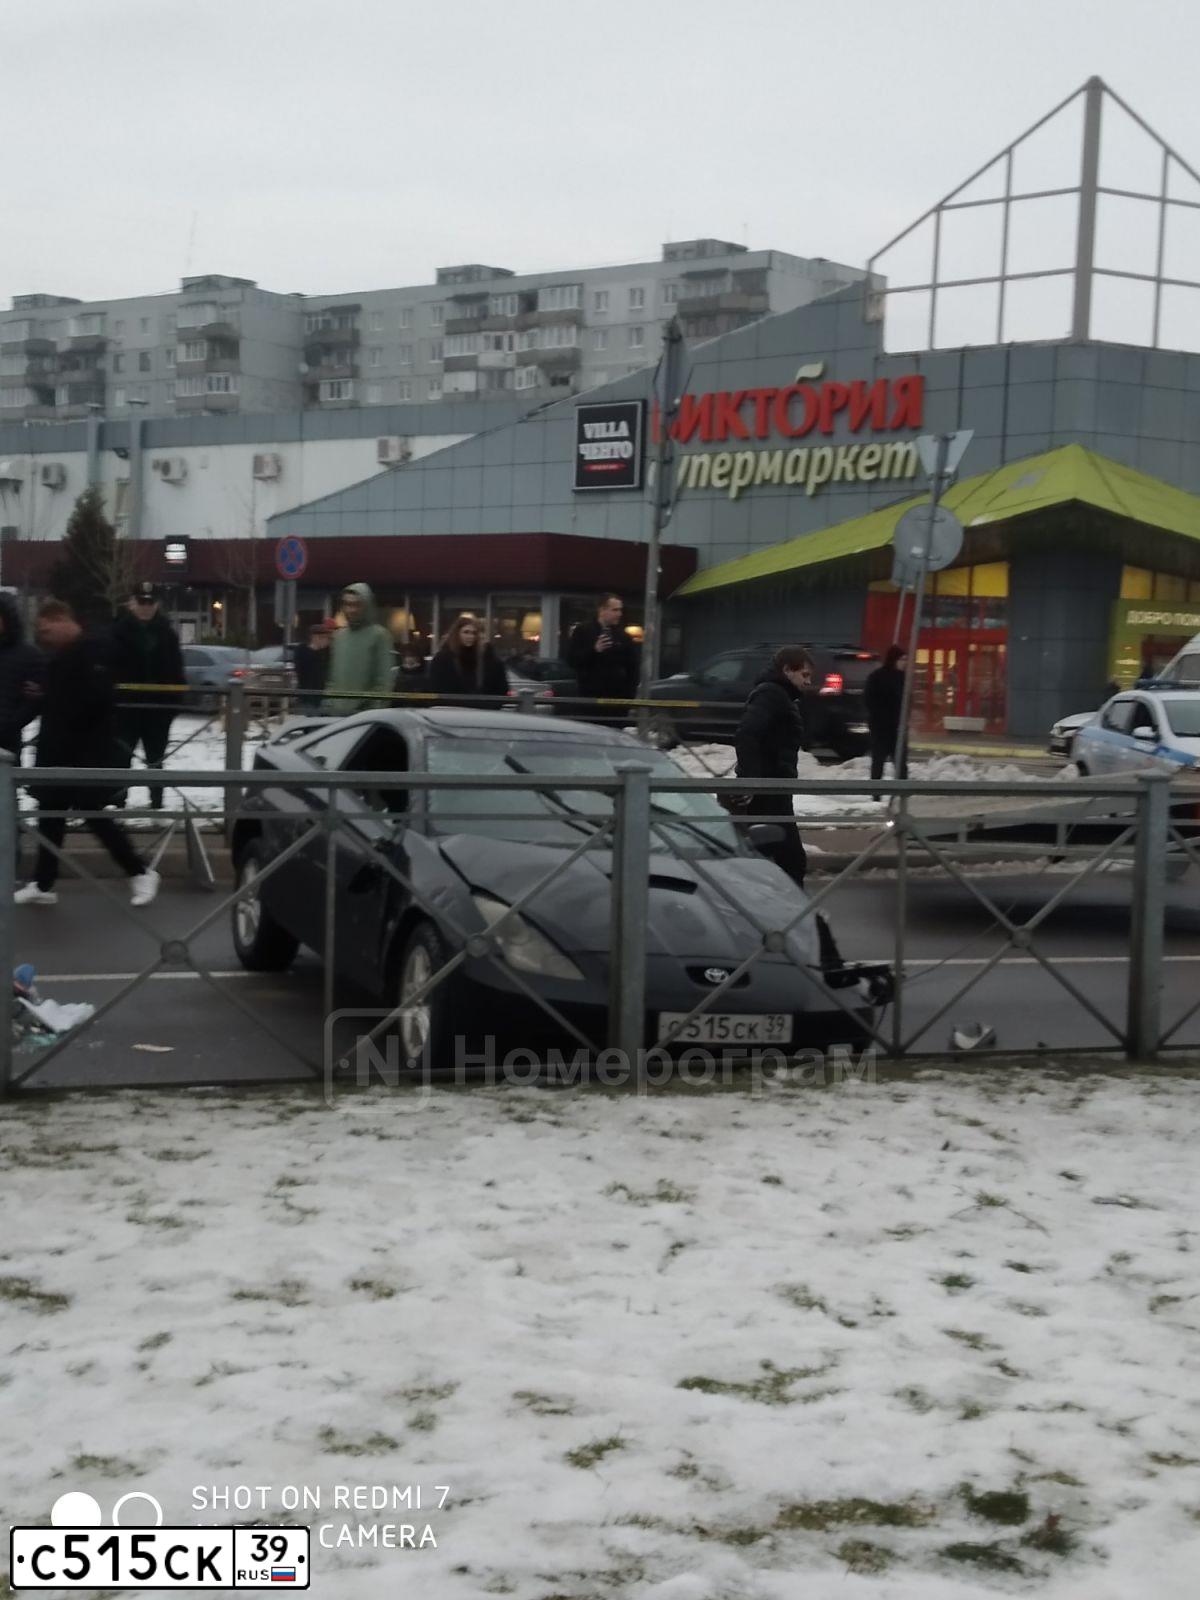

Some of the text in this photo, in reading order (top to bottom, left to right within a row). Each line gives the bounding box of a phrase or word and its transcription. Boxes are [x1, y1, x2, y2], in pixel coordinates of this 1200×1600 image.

[583, 420, 629, 439] VILLA
[652, 374, 925, 445] ИКТОРИЯ
[649, 441, 918, 499] пермаркет
